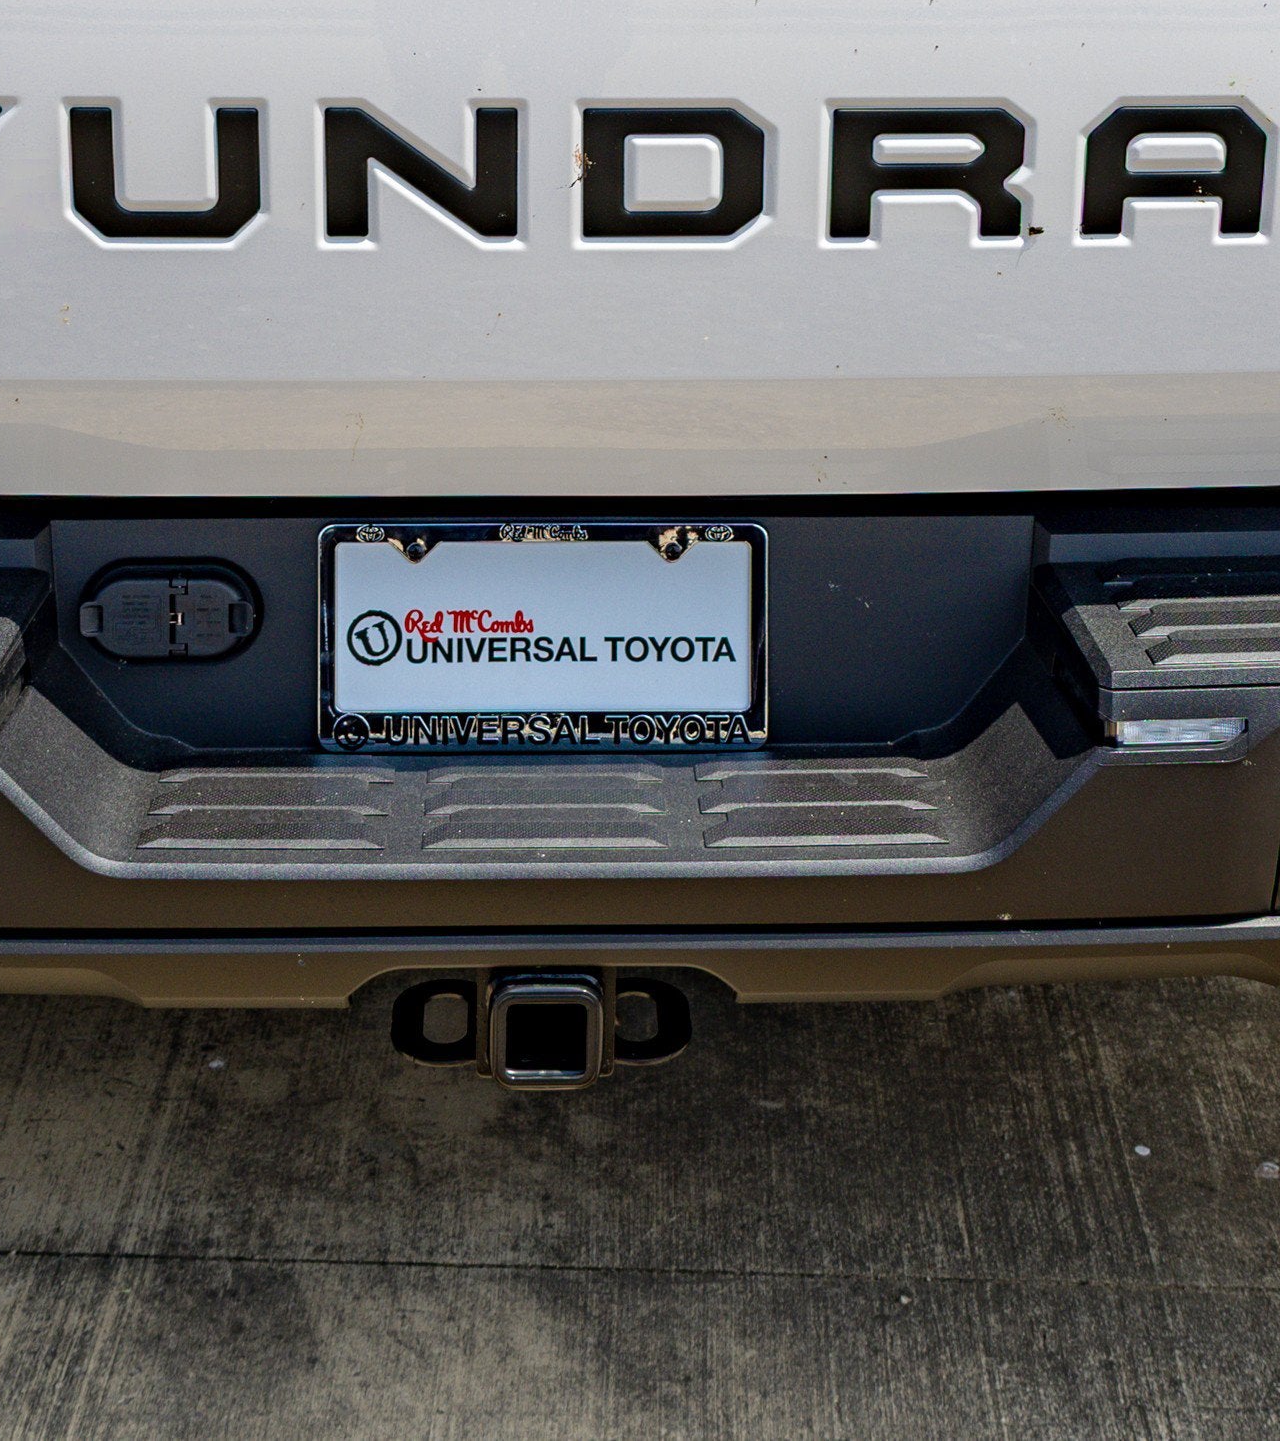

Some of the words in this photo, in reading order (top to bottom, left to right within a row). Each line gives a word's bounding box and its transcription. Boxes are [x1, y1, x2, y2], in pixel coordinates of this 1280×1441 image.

[404, 609, 444, 643] Red
[446, 609, 535, 634] McCombs
[406, 635, 598, 664] UNIVERSAL
[604, 635, 738, 663] TOYOTA
[383, 714, 600, 746] UNIVERSAL
[605, 714, 752, 746] TOYOTA
